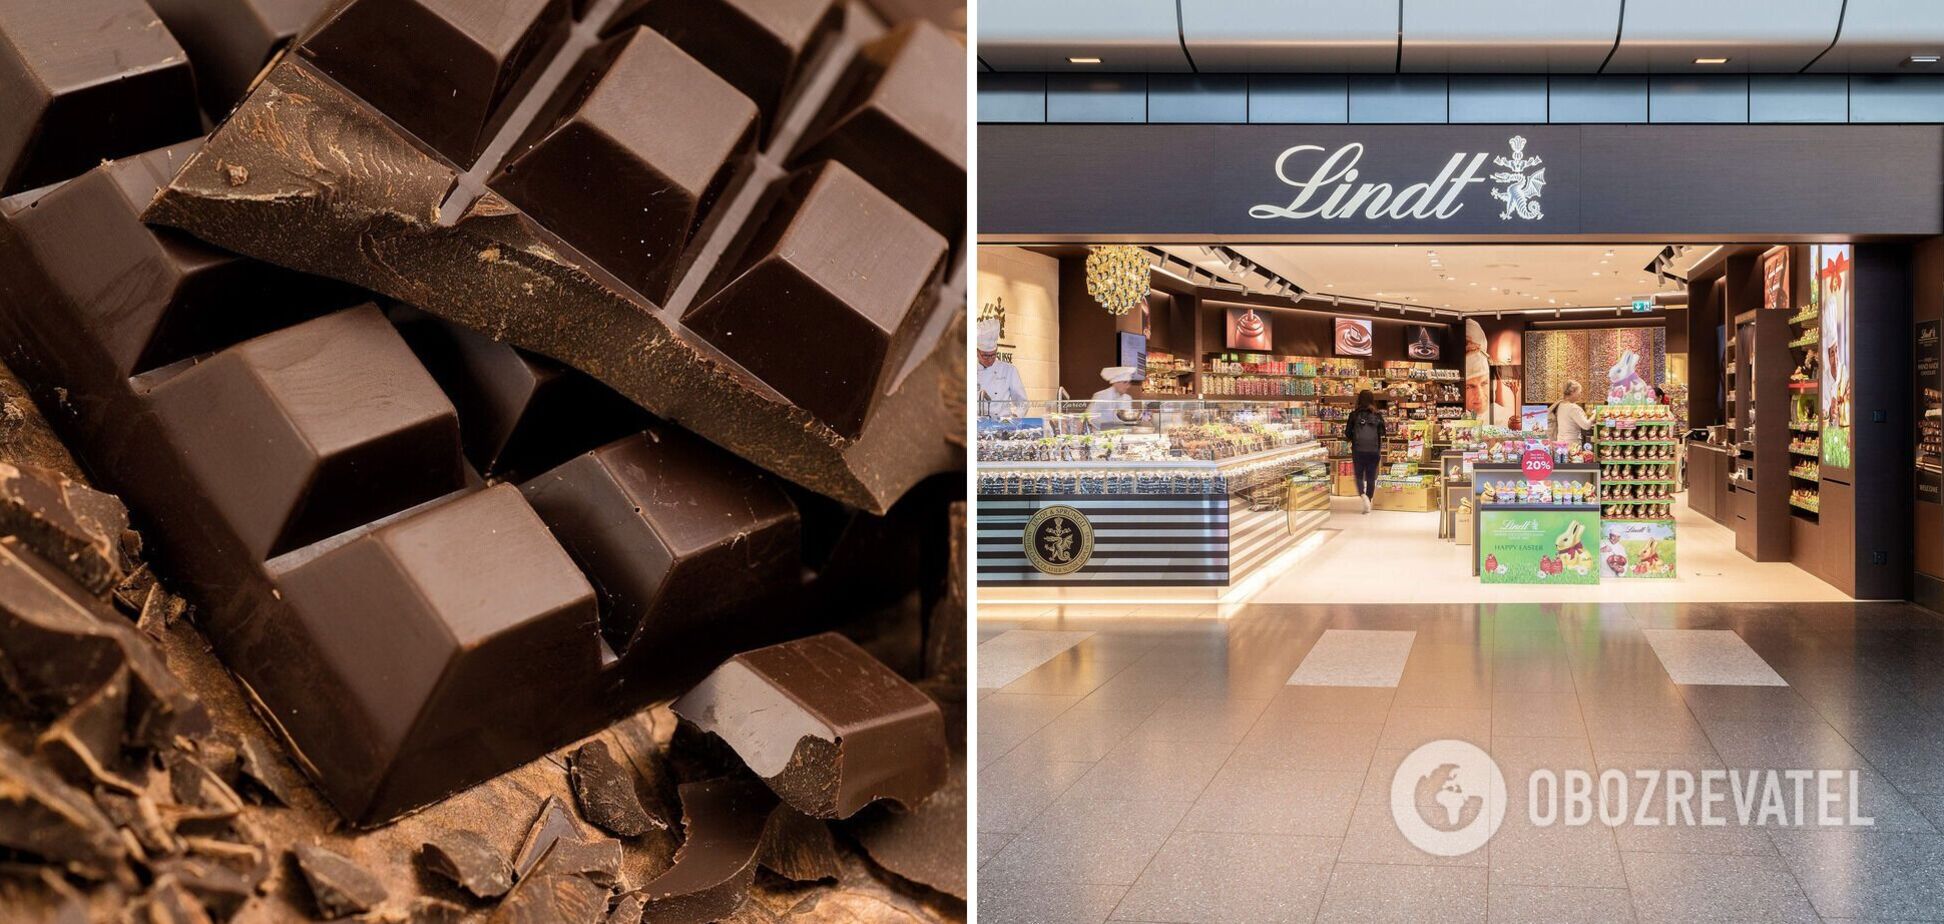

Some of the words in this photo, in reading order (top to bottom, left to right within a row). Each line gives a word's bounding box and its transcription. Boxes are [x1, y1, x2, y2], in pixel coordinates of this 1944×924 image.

[1248, 142, 1489, 220] Lindt
[1526, 461, 1550, 470] 20%
[1499, 520, 1530, 530] Lindt
[1495, 544, 1517, 552] HAPPY
[1519, 544, 1544, 552] EASTER
